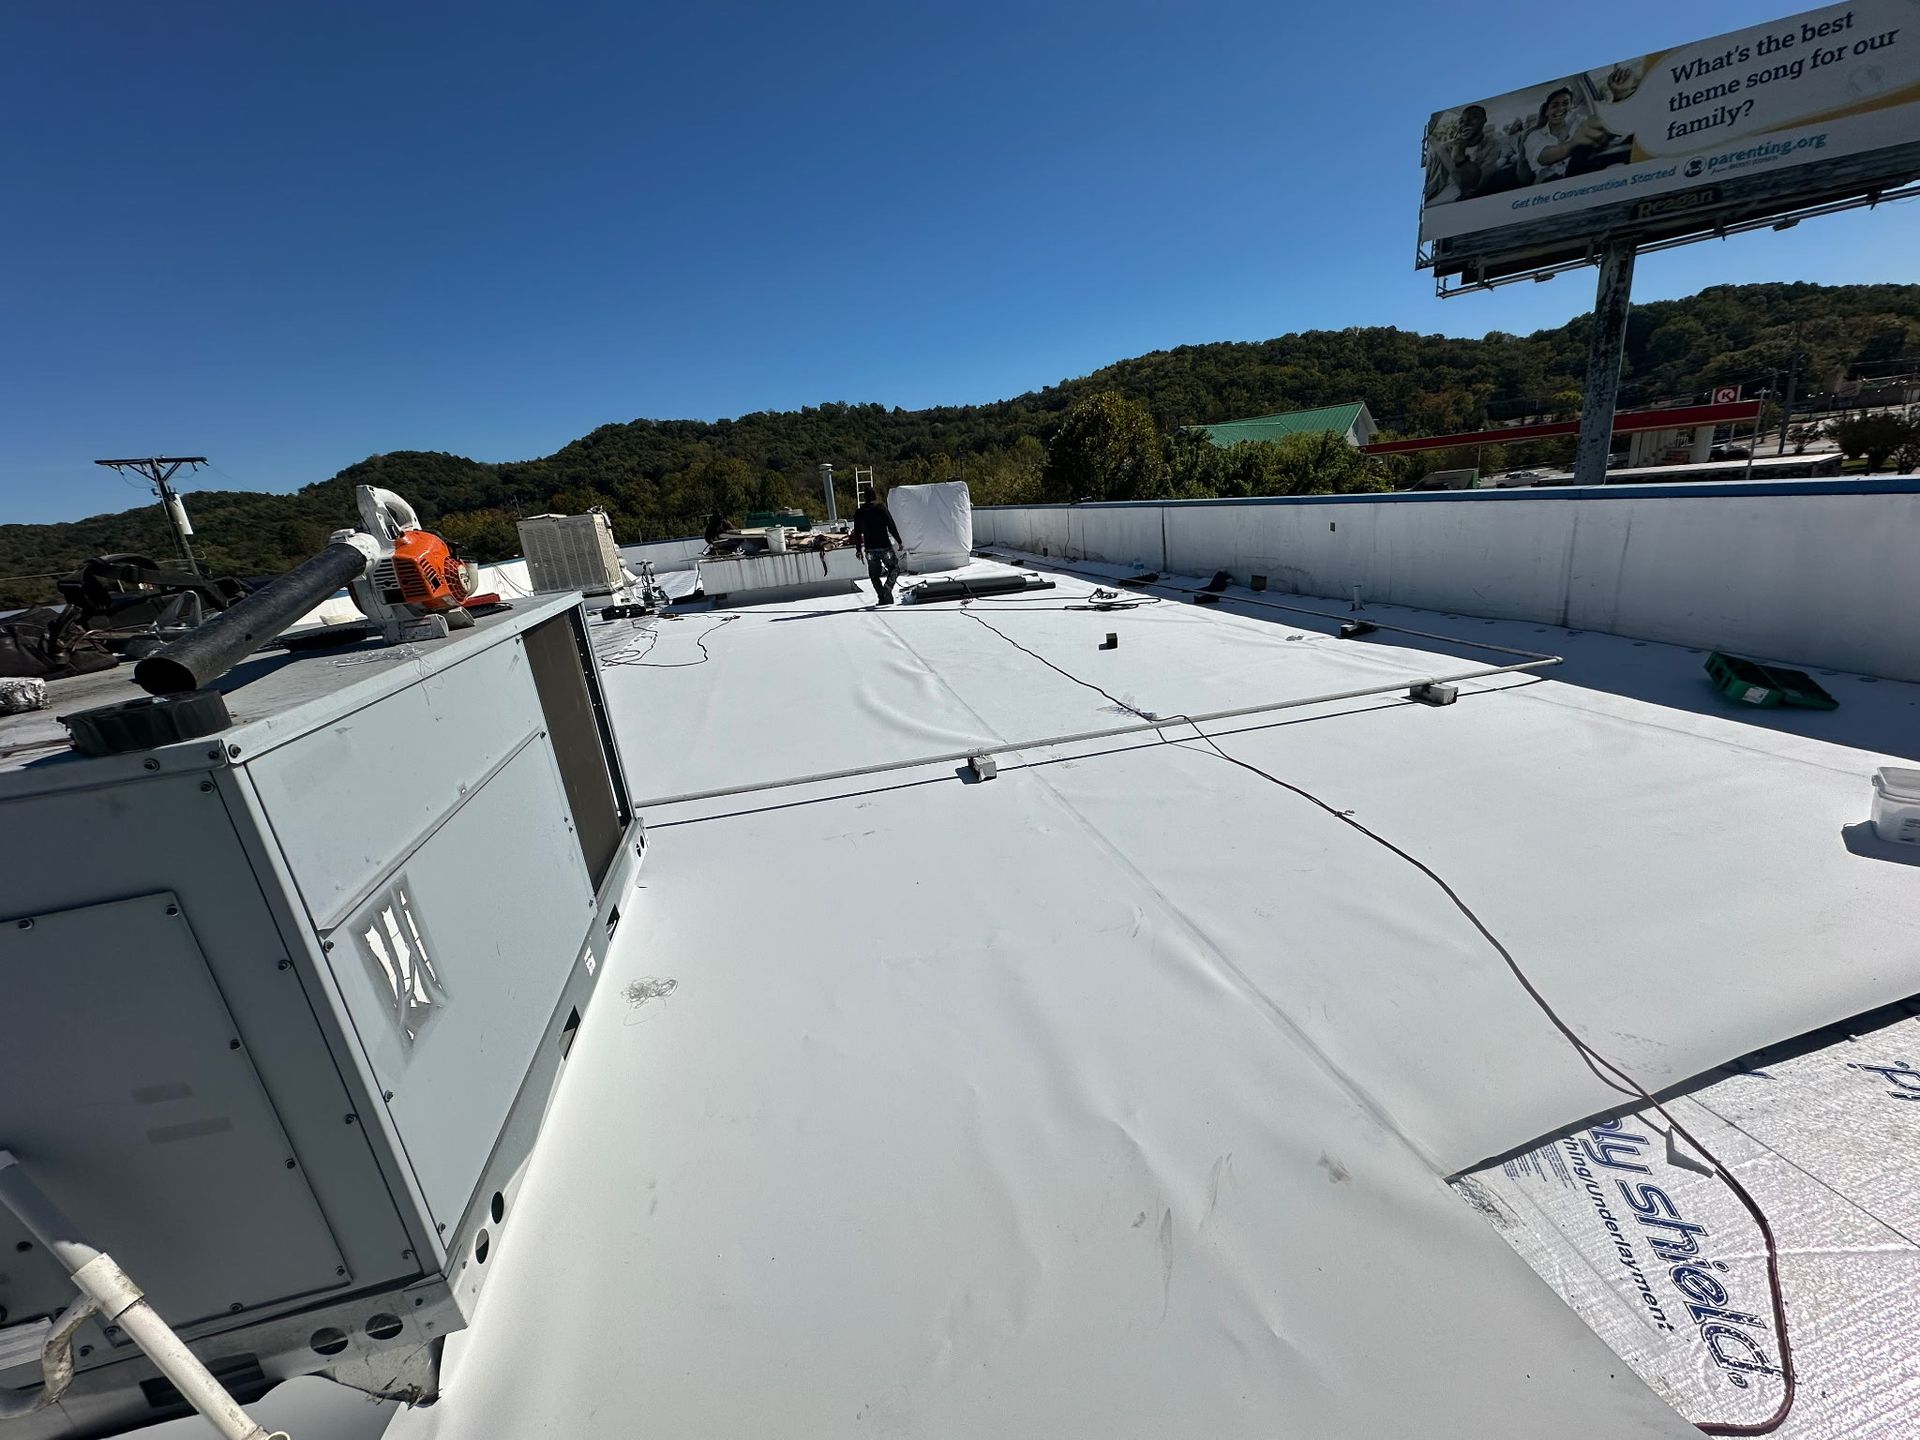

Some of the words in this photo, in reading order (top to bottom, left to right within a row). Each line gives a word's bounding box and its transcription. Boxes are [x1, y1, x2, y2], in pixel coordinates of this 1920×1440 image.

[1670, 45, 1750, 84] What's
[1757, 33, 1796, 58] the
[1801, 11, 1855, 44] best
[1668, 79, 1741, 112] theme
[1745, 58, 1804, 89] song
[1810, 45, 1849, 70] for
[1853, 29, 1901, 56] our
[1666, 98, 1755, 141] family?
[1707, 132, 1830, 170] parenting.org
[1511, 197, 1531, 211] Get
[1532, 193, 1551, 207] the
[1552, 178, 1629, 202] Conversation
[1630, 166, 1677, 186] Started
